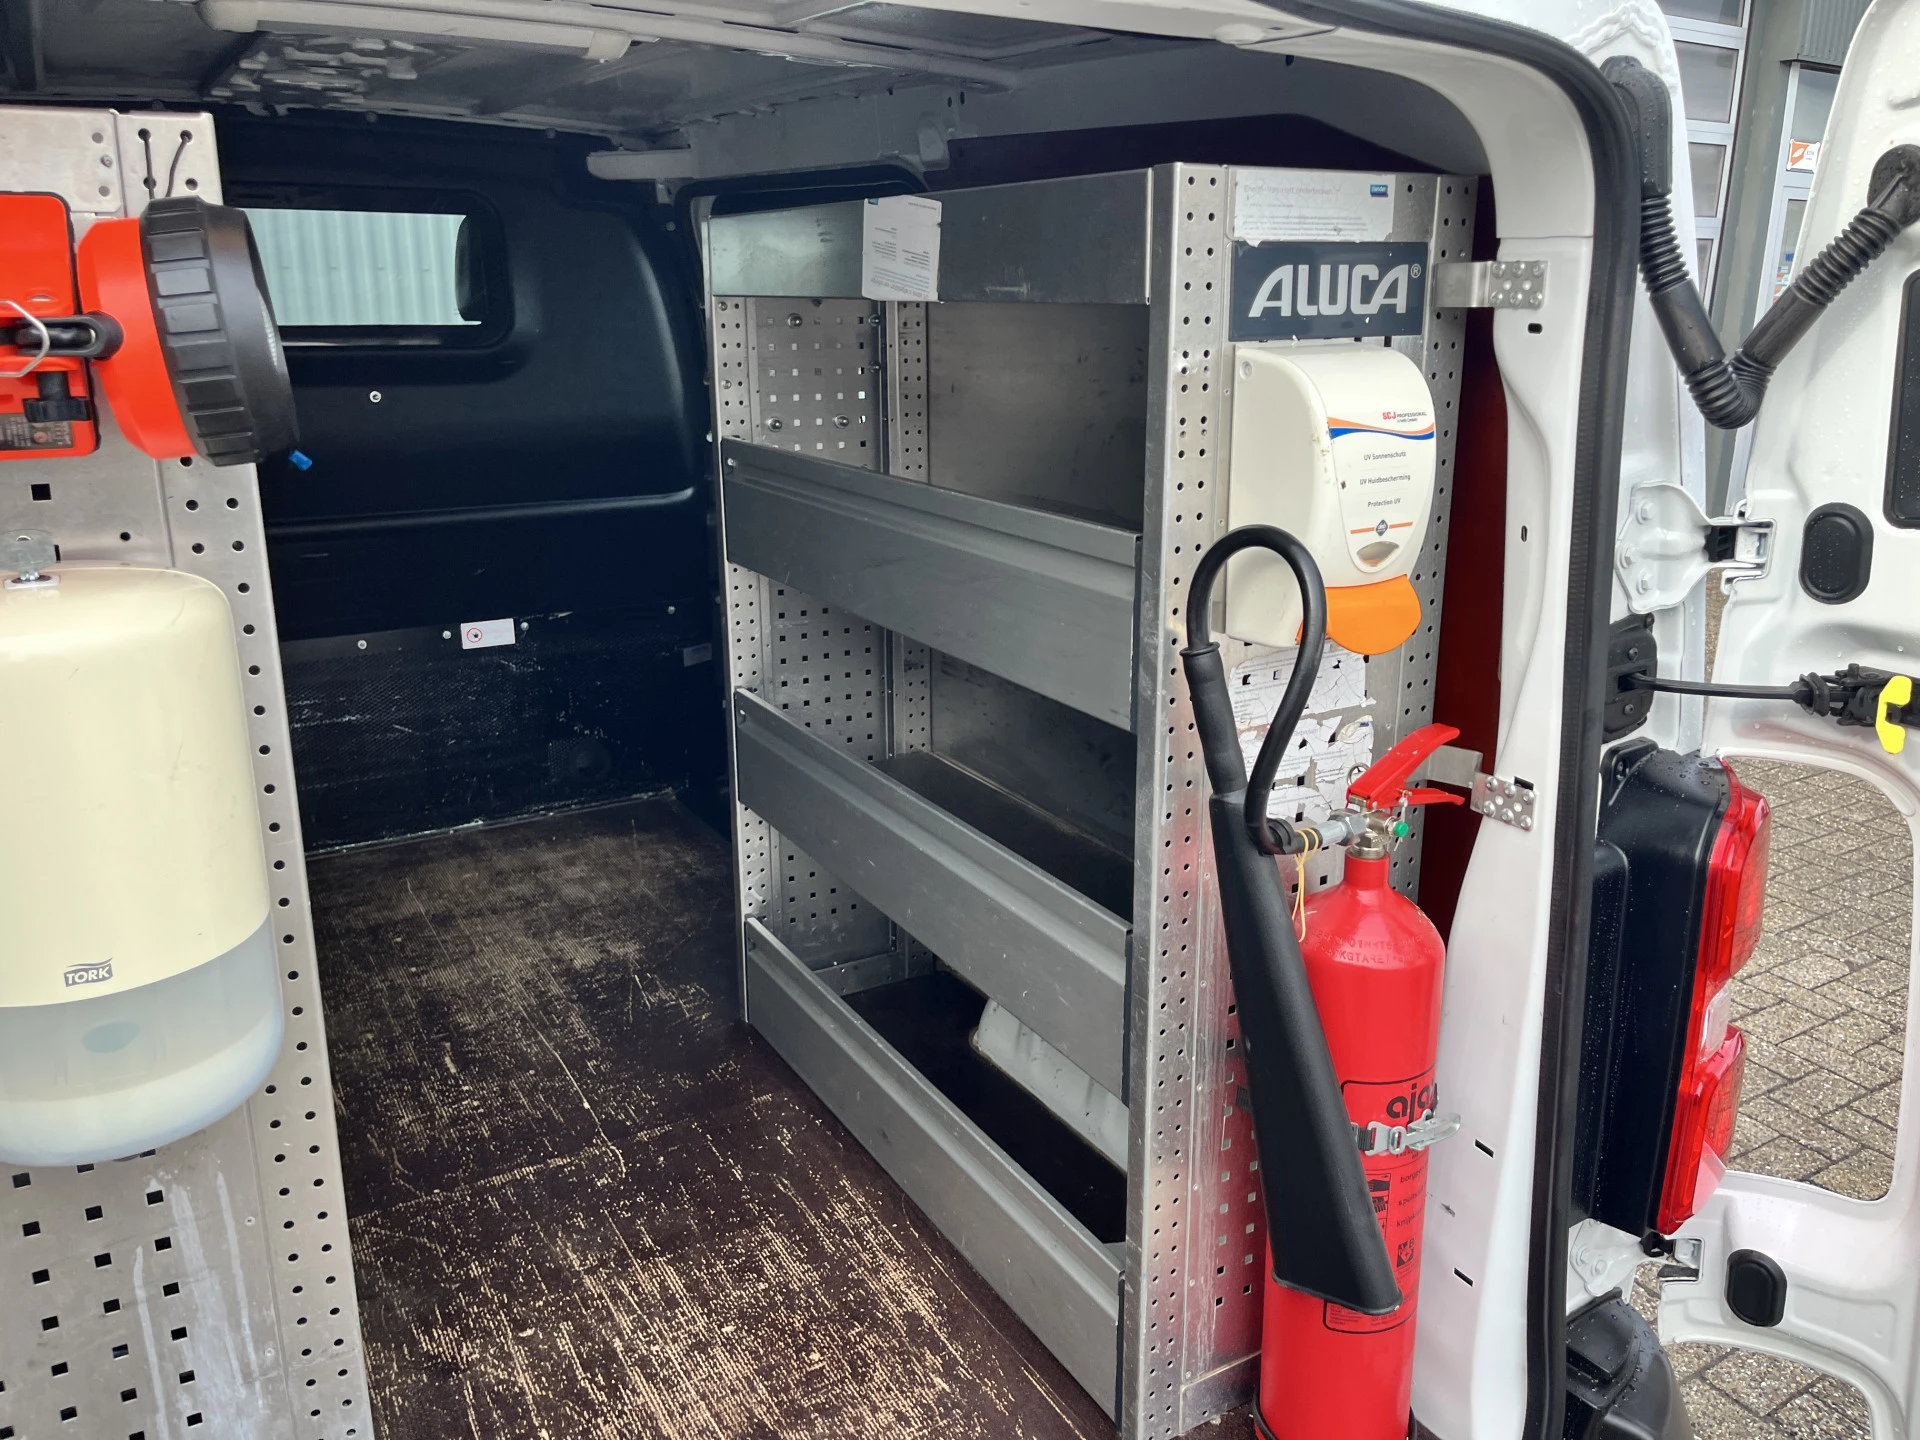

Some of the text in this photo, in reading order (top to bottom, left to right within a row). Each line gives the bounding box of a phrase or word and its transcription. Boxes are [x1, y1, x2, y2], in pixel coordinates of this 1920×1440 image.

[1382, 411, 1396, 420] SCJ
[1372, 451, 1406, 460] Sonnenschutz
[1368, 474, 1411, 484] Huidbescherming
[1367, 499, 1393, 507] Protection
[66, 966, 109, 985] TORK
